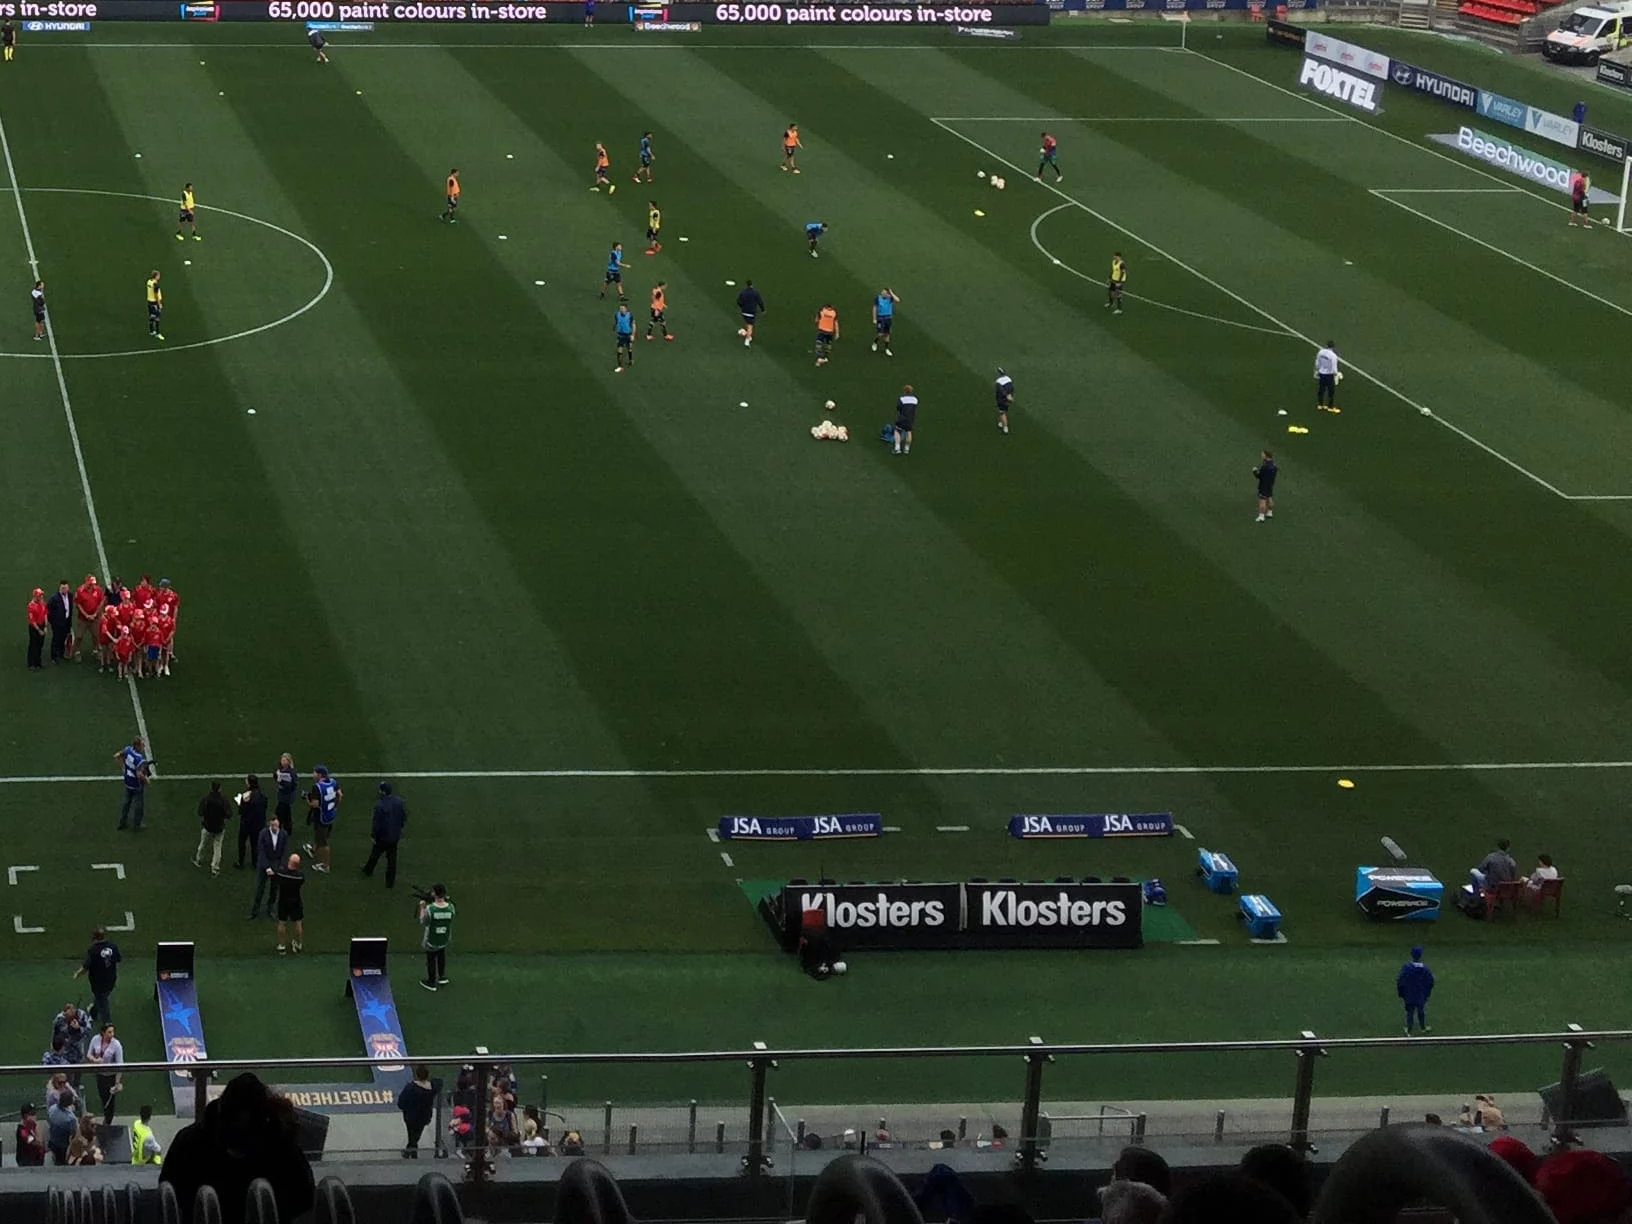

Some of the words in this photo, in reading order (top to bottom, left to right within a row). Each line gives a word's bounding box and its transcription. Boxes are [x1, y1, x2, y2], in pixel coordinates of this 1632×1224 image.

[20, 0, 97, 17] in-store
[268, 2, 334, 20] 65,000
[339, 1, 389, 21] paint
[394, 2, 466, 19] colours
[471, 2, 547, 19] in-store
[716, 4, 782, 23] 65,000
[786, 5, 836, 23] paint
[840, 5, 912, 22] colours
[917, 5, 993, 22] in-store
[45, 22, 85, 30] HYUNDAI
[644, 22, 691, 31] Beechwood
[1300, 58, 1377, 111] FOXTEL
[1416, 73, 1474, 107] HYUNDAI
[1493, 98, 1523, 118] VARLEY
[1582, 131, 1623, 158] Klosters
[1458, 126, 1571, 187] Beechwood
[730, 817, 762, 834] JSA
[766, 827, 795, 835] GROUP
[812, 816, 843, 833] JSA
[845, 823, 874, 832] GROUP
[1022, 816, 1053, 833] JSA
[1056, 824, 1085, 832] GROUP
[1103, 814, 1133, 831] JSA
[1136, 822, 1166, 830] GROUP
[982, 890, 1126, 926] Klosters
